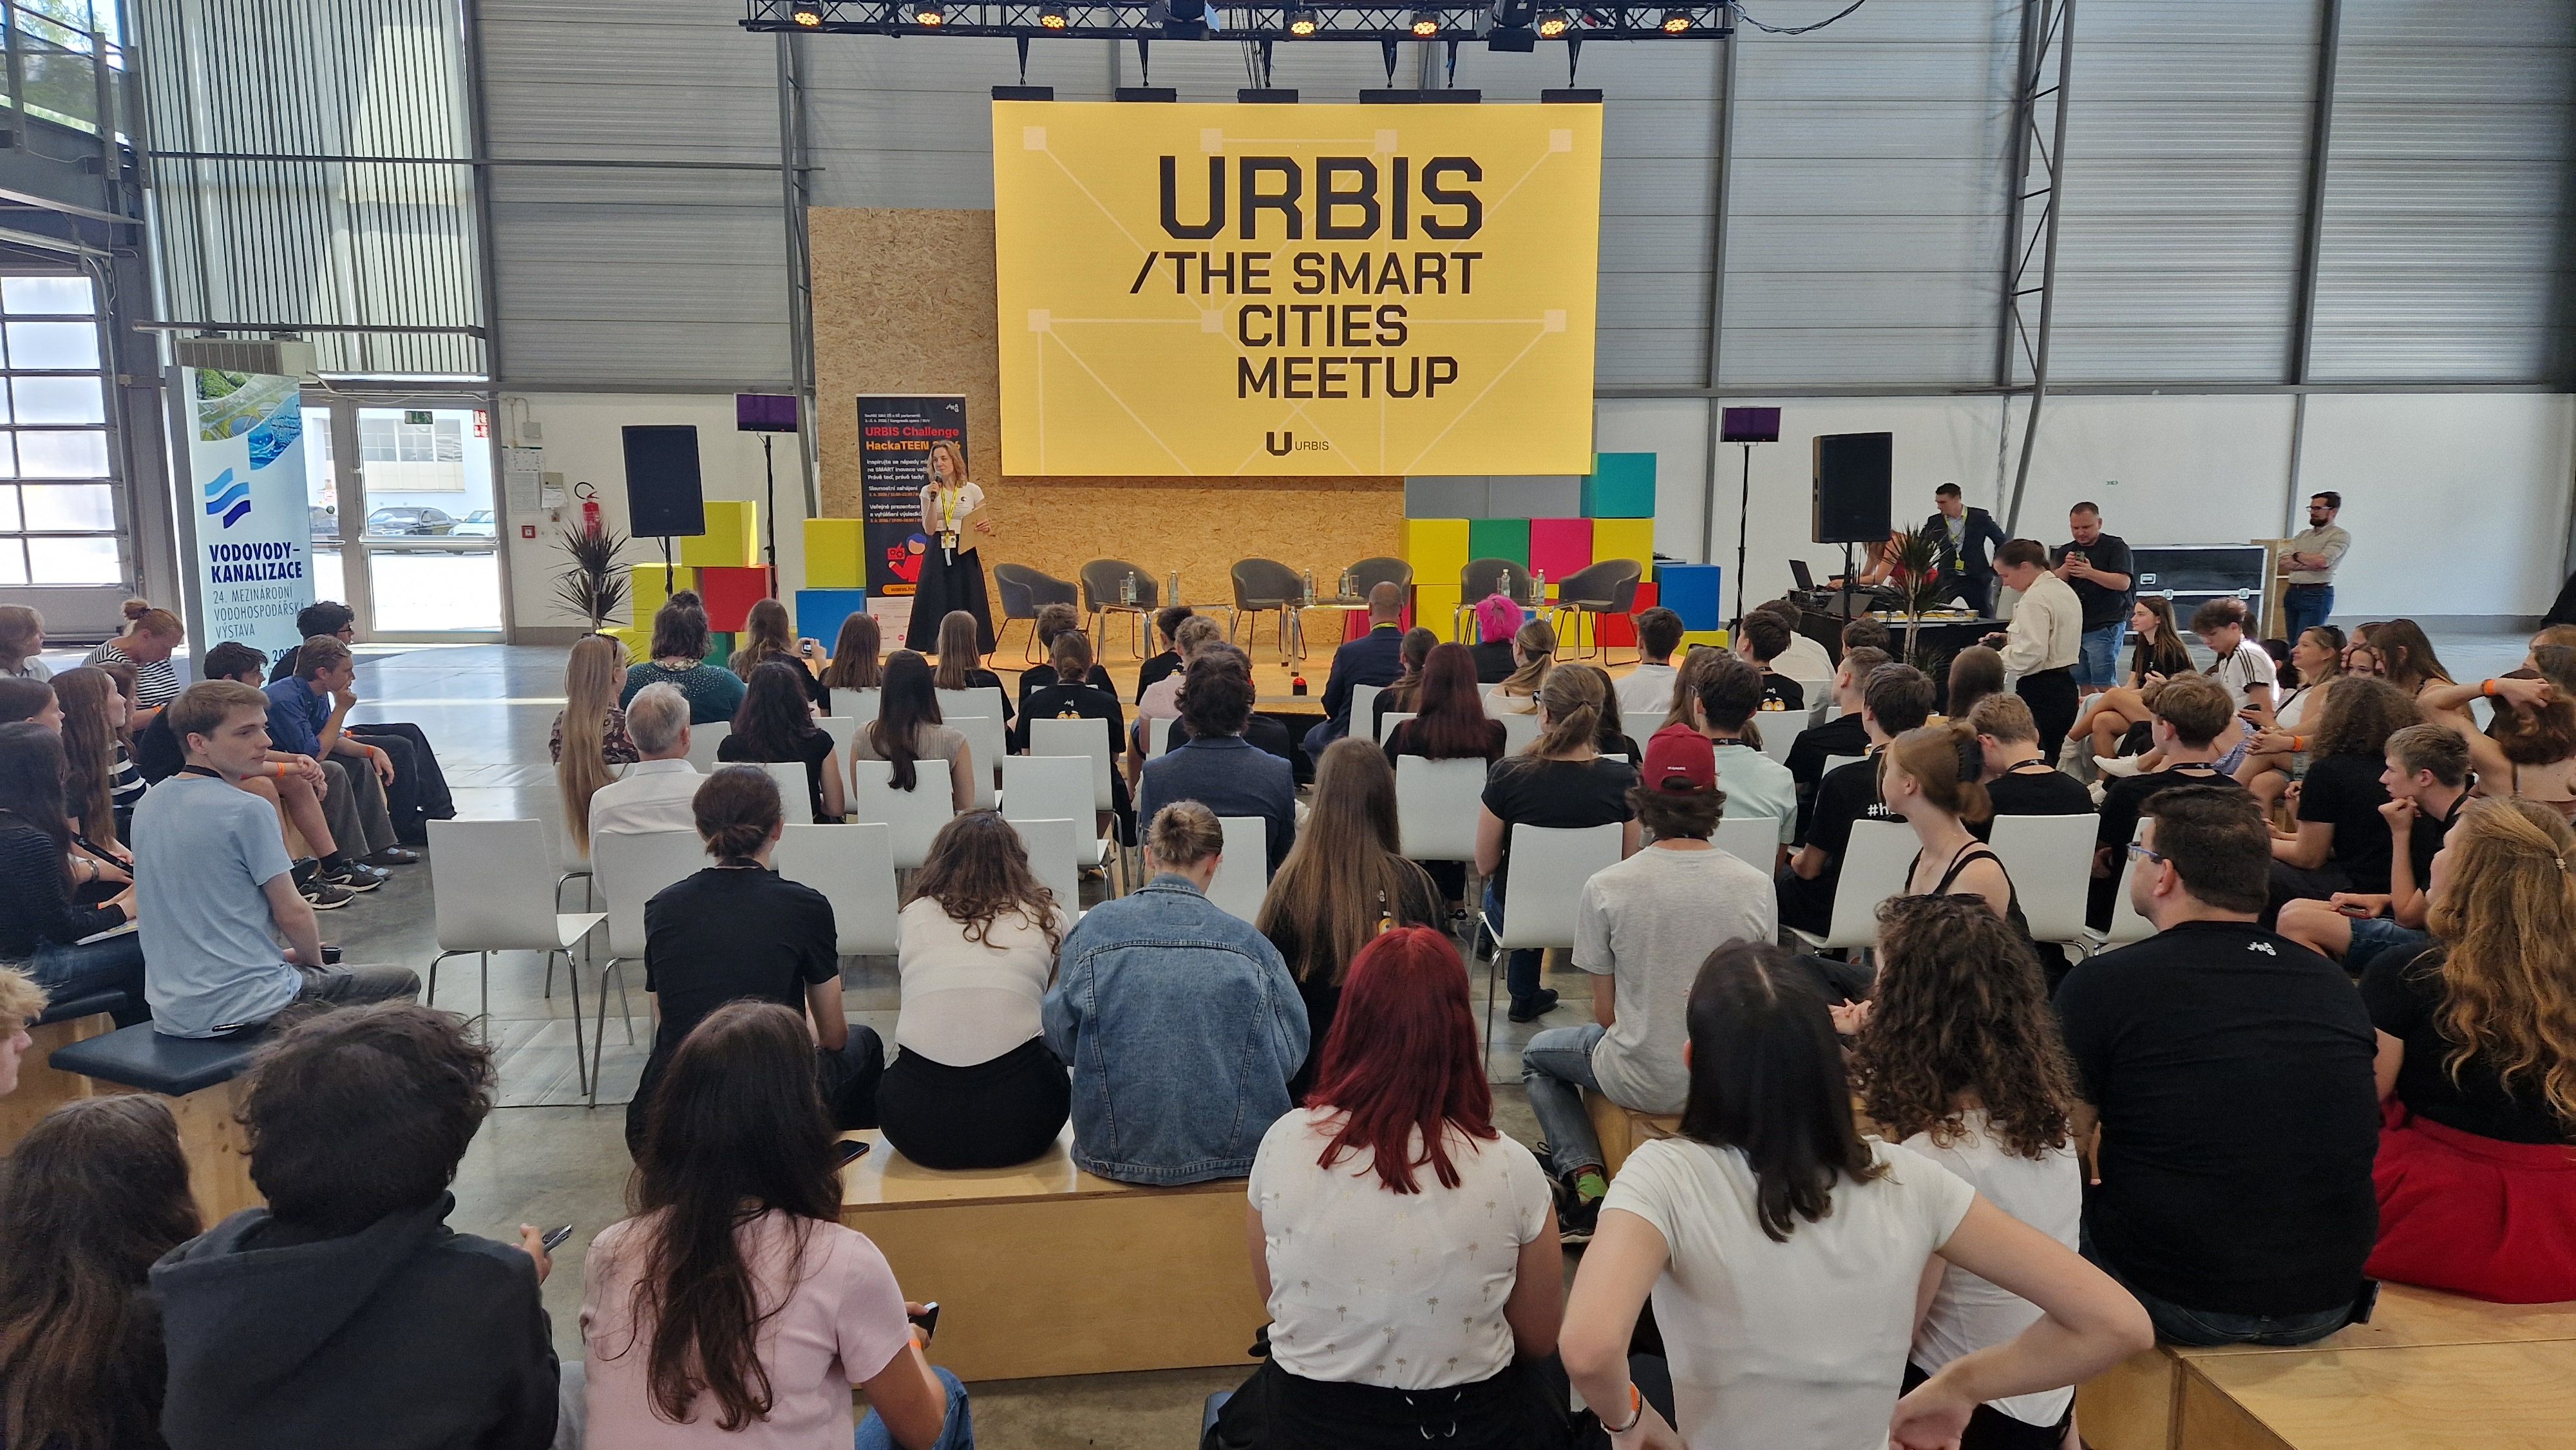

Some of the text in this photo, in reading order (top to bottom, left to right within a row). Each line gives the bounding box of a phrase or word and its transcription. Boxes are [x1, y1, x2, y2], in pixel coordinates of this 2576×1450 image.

[1160, 155, 1482, 240] URBIS
[1129, 251, 1483, 295] /THE SMART
[1238, 304, 1408, 347] CITIES
[1238, 356, 1458, 399] MEETUP
[865, 426, 960, 439] URBIS Challenge
[866, 440, 930, 451] HackaTEEN
[1294, 440, 1329, 451] URBIS
[211, 561, 303, 583] KANALIZACE
[213, 582, 293, 604] 24. MEZINÁRODNÍ
[215, 622, 256, 639] VÝSTAVA
